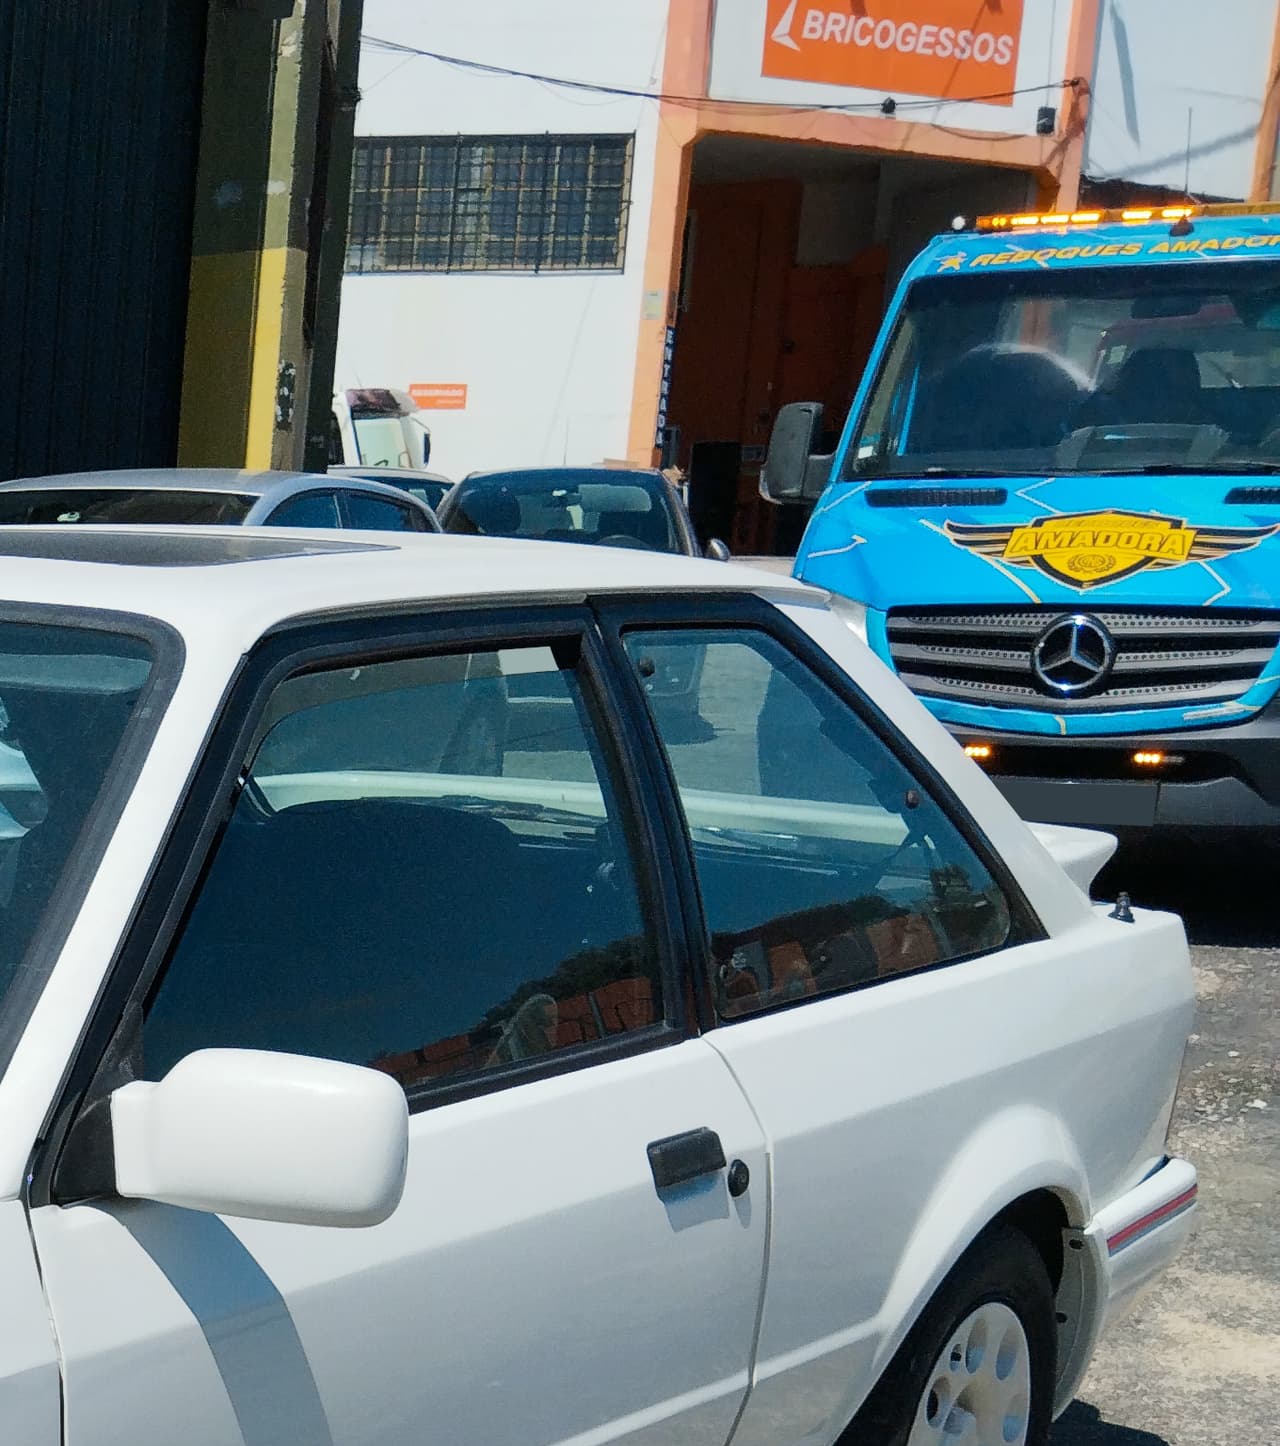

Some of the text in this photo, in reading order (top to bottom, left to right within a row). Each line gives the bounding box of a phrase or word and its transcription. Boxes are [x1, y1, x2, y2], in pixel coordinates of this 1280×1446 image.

[801, 9, 1014, 65] BRICOGESSOS
[969, 243, 1141, 267] REBOQUES
[1010, 529, 1186, 556] AMADORA
